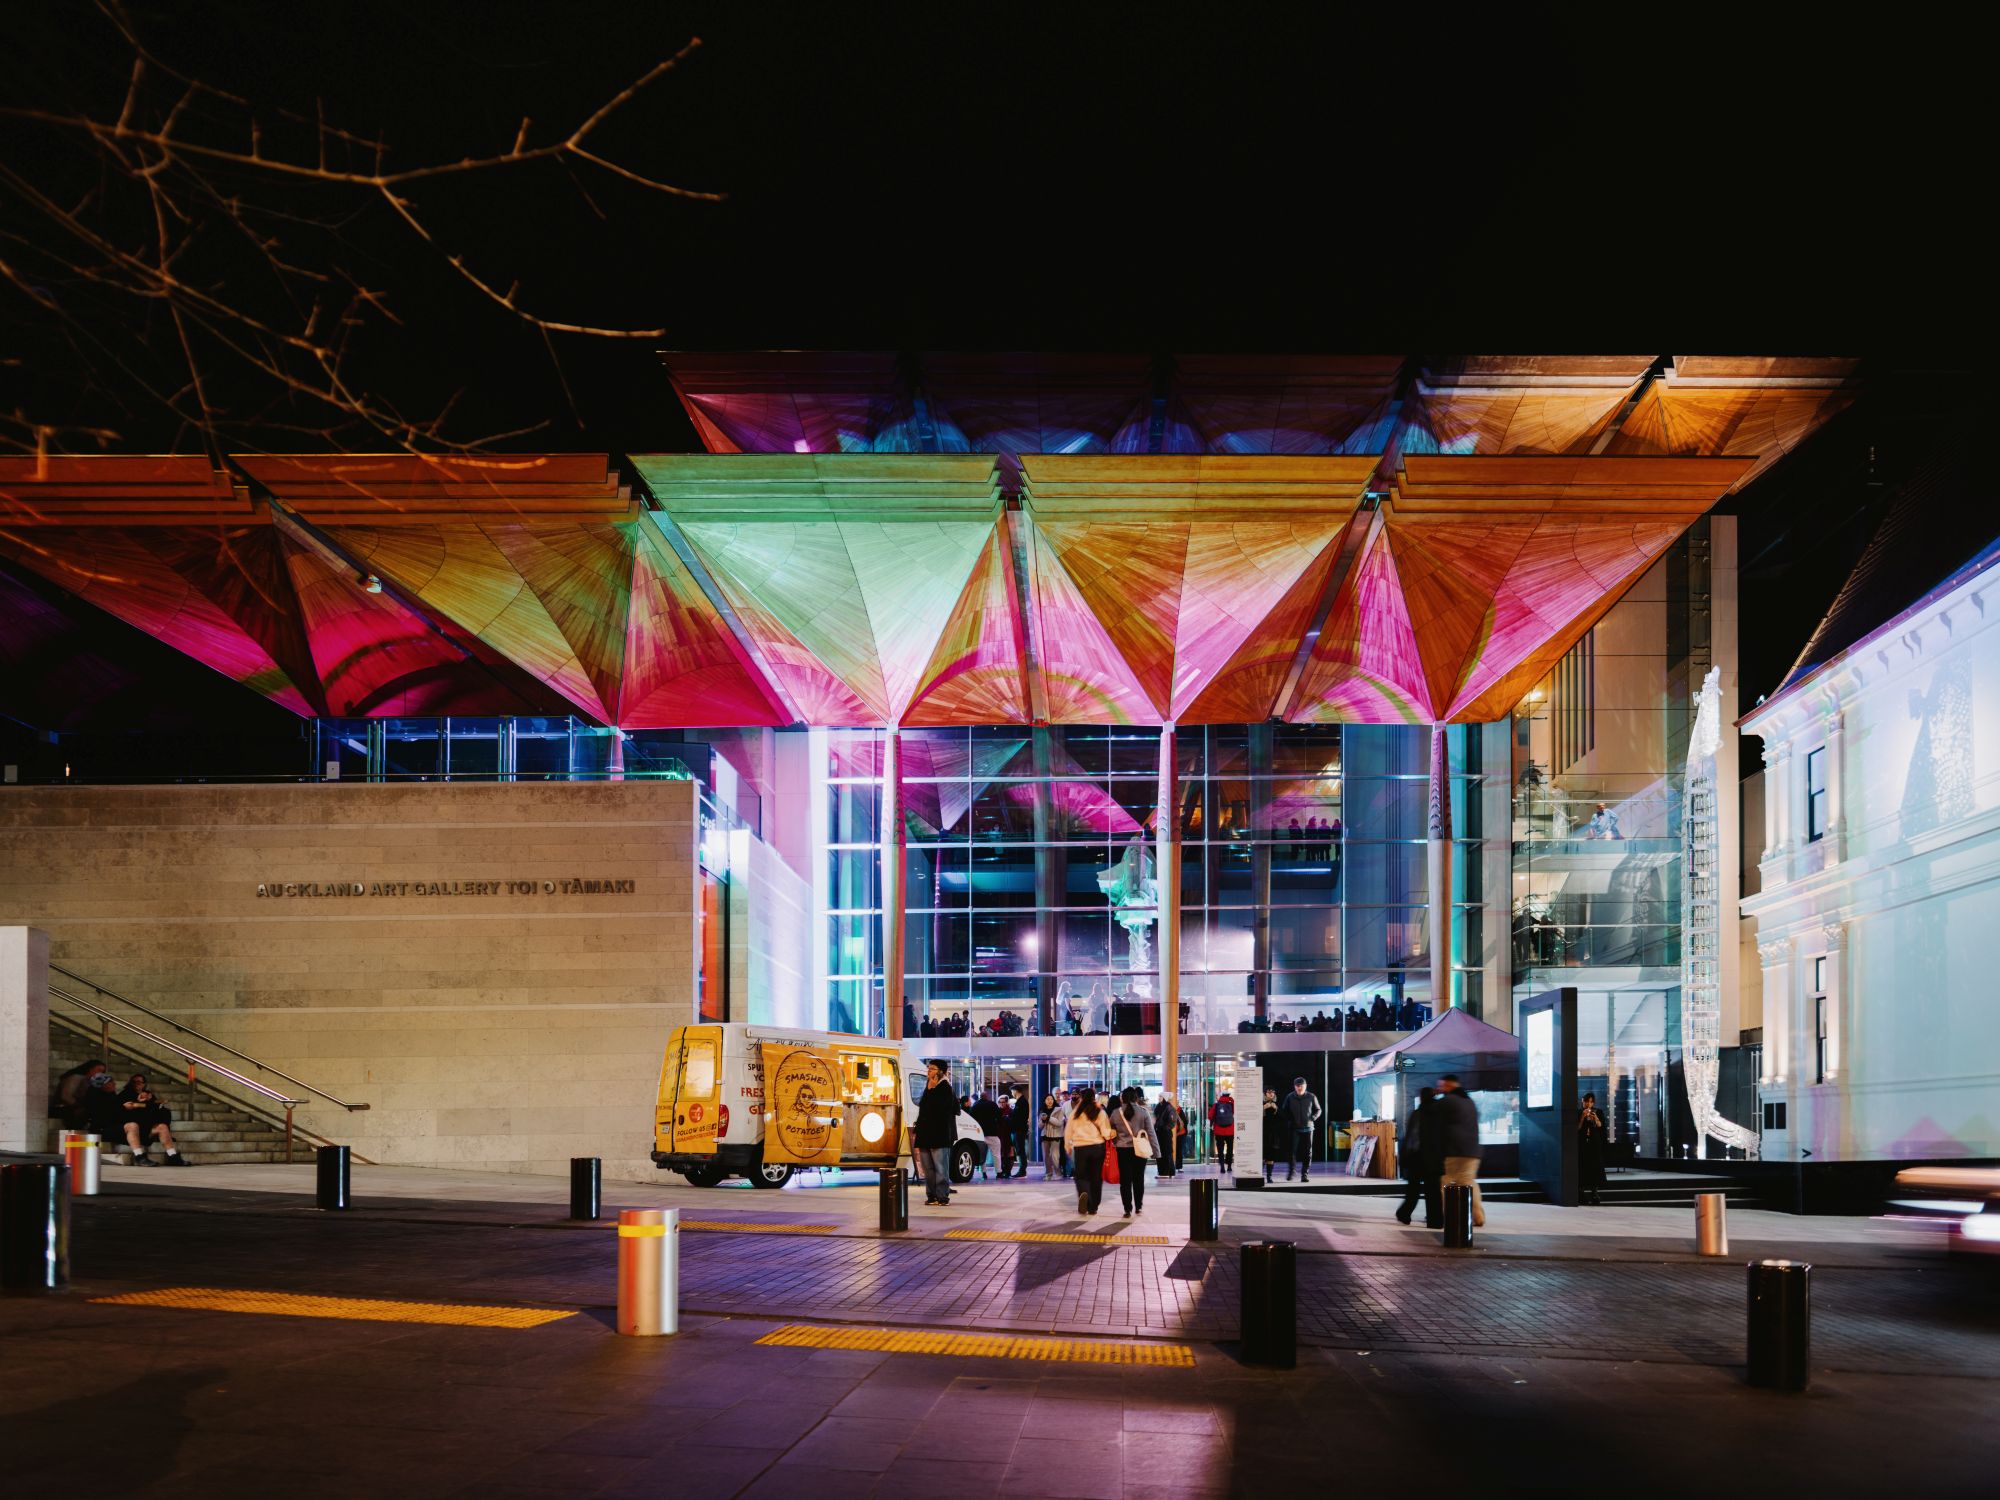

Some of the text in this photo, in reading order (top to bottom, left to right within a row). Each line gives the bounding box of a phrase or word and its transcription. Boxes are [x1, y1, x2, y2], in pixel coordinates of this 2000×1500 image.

[256, 877, 635, 898] AUCKLAND ART GALLERY TOI O TĀMAKI
[785, 1073, 828, 1086] SMASHED
[677, 1127, 698, 1137] FOLLOW
[785, 1124, 825, 1136] POTATOES
